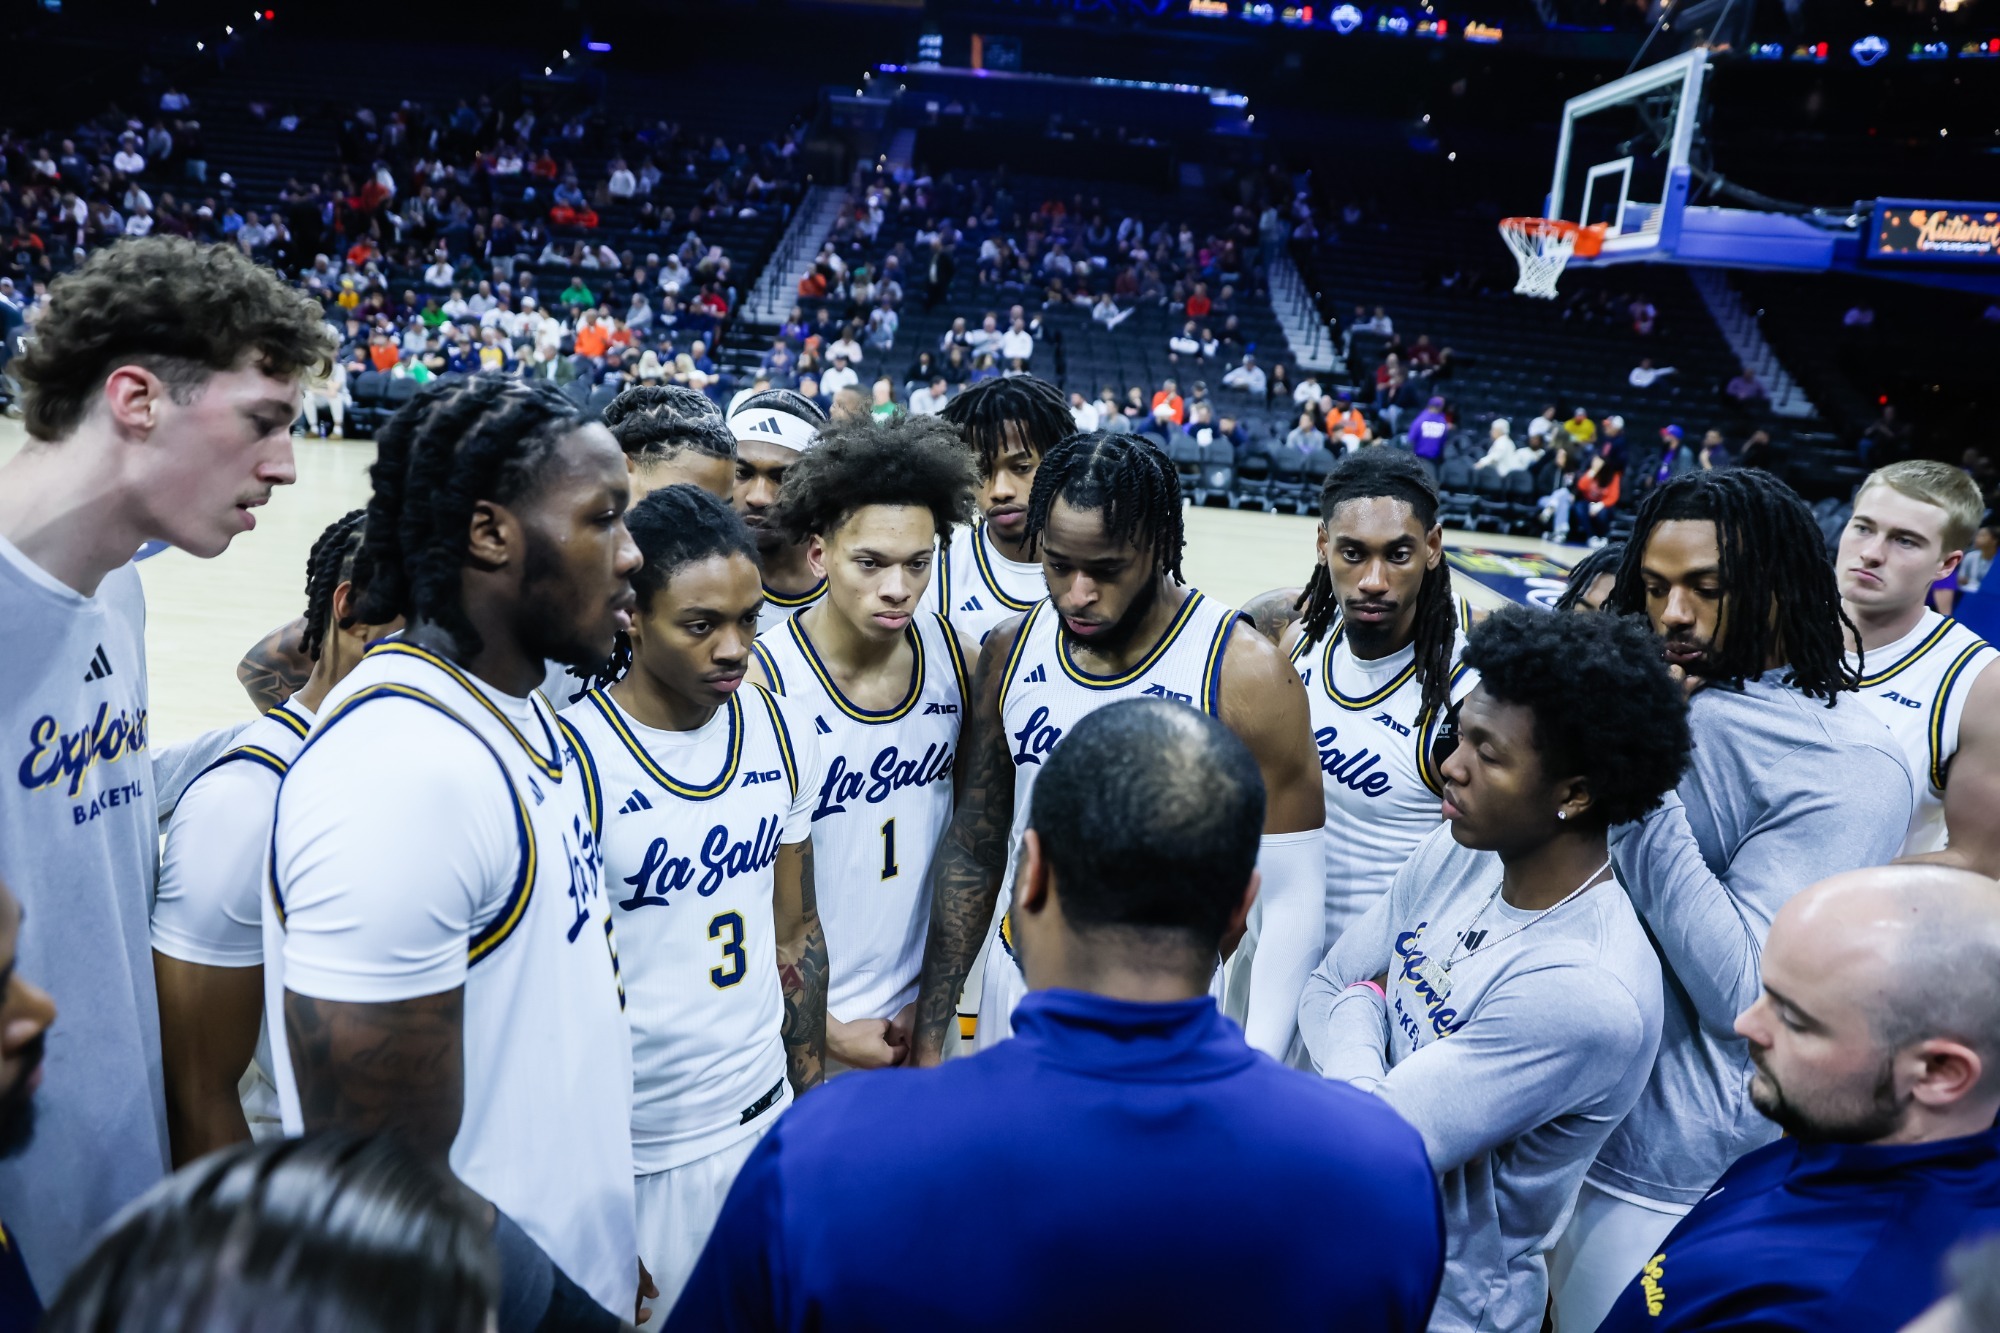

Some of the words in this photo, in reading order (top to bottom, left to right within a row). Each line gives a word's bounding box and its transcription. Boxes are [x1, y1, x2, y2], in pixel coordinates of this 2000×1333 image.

[922, 703, 958, 715] A10
[1372, 712, 1411, 737] A10
[1880, 690, 1921, 709] A10
[1013, 706, 1063, 766] La
[741, 769, 781, 787] A10
[811, 755, 865, 822] La
[865, 742, 955, 803] Salle
[619, 837, 695, 911] La
[697, 813, 784, 897] Salle
[880, 816, 899, 882] 1
[706, 909, 748, 990] 3
